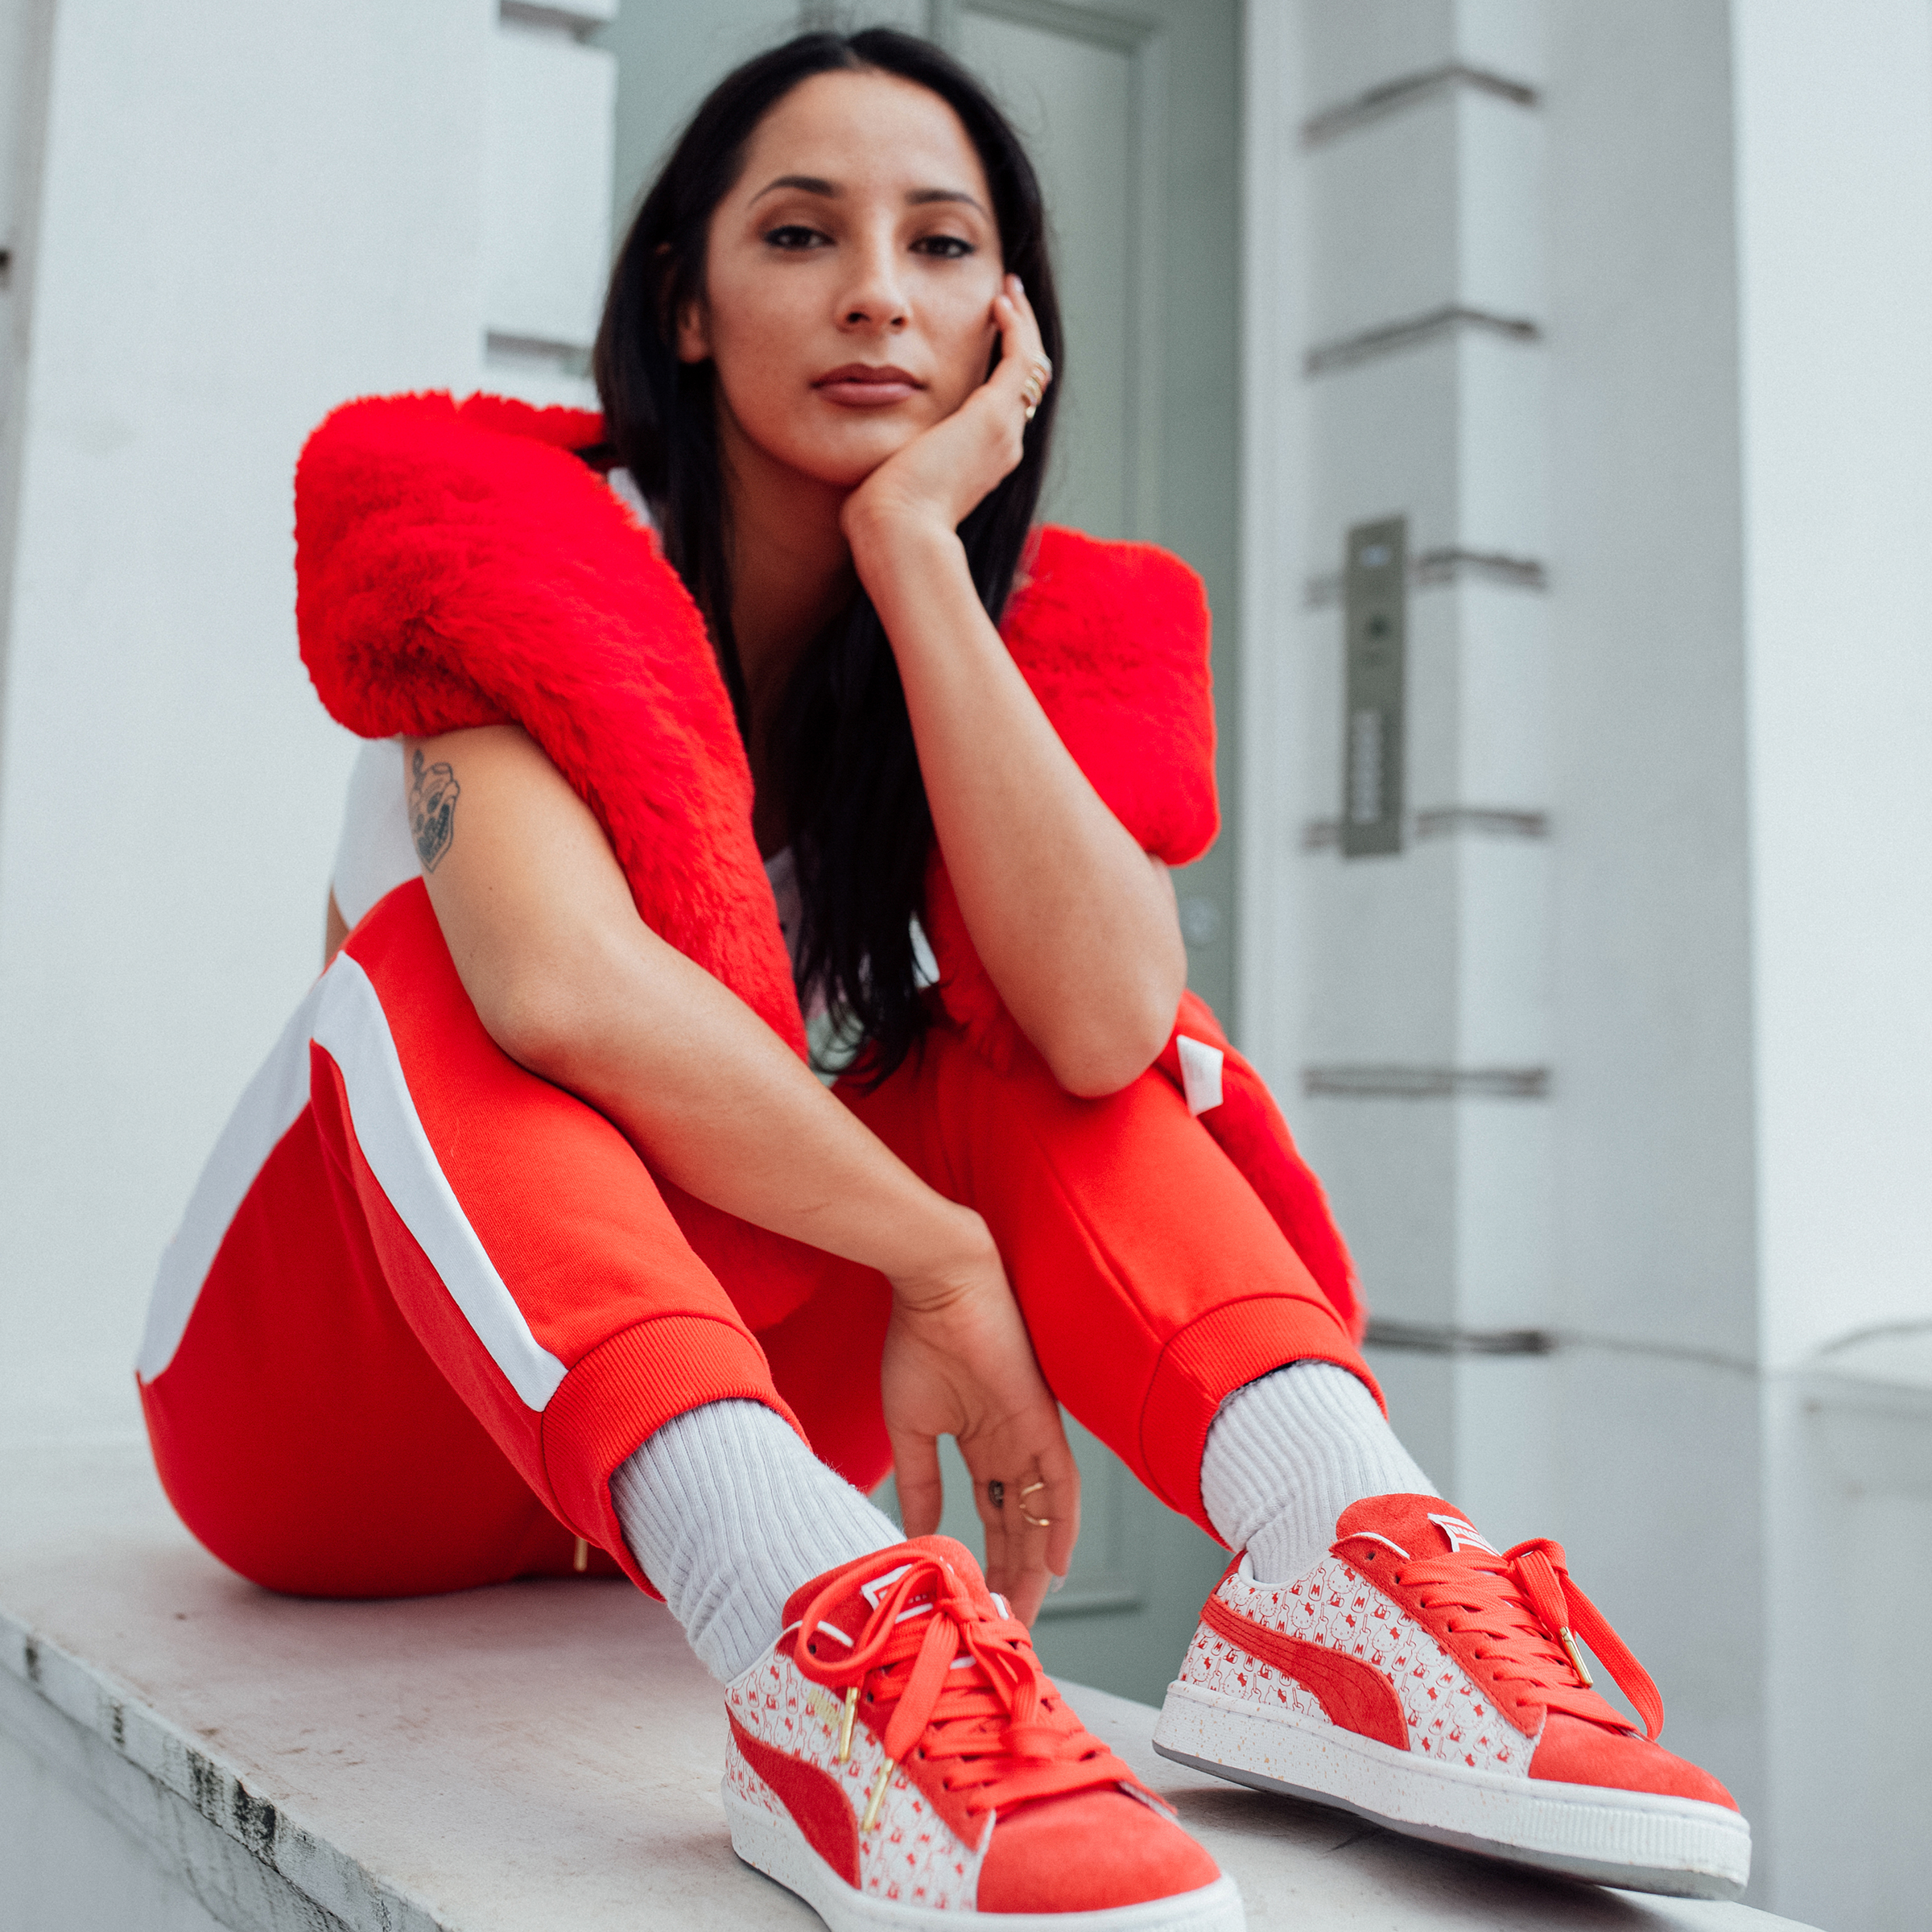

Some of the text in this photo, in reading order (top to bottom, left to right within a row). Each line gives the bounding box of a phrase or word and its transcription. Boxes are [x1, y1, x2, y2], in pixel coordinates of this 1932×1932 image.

[1311, 1584, 1320, 1596] M
[1354, 1597, 1364, 1608] M
[1315, 1633, 1323, 1644] M
[1354, 1644, 1364, 1654] M
